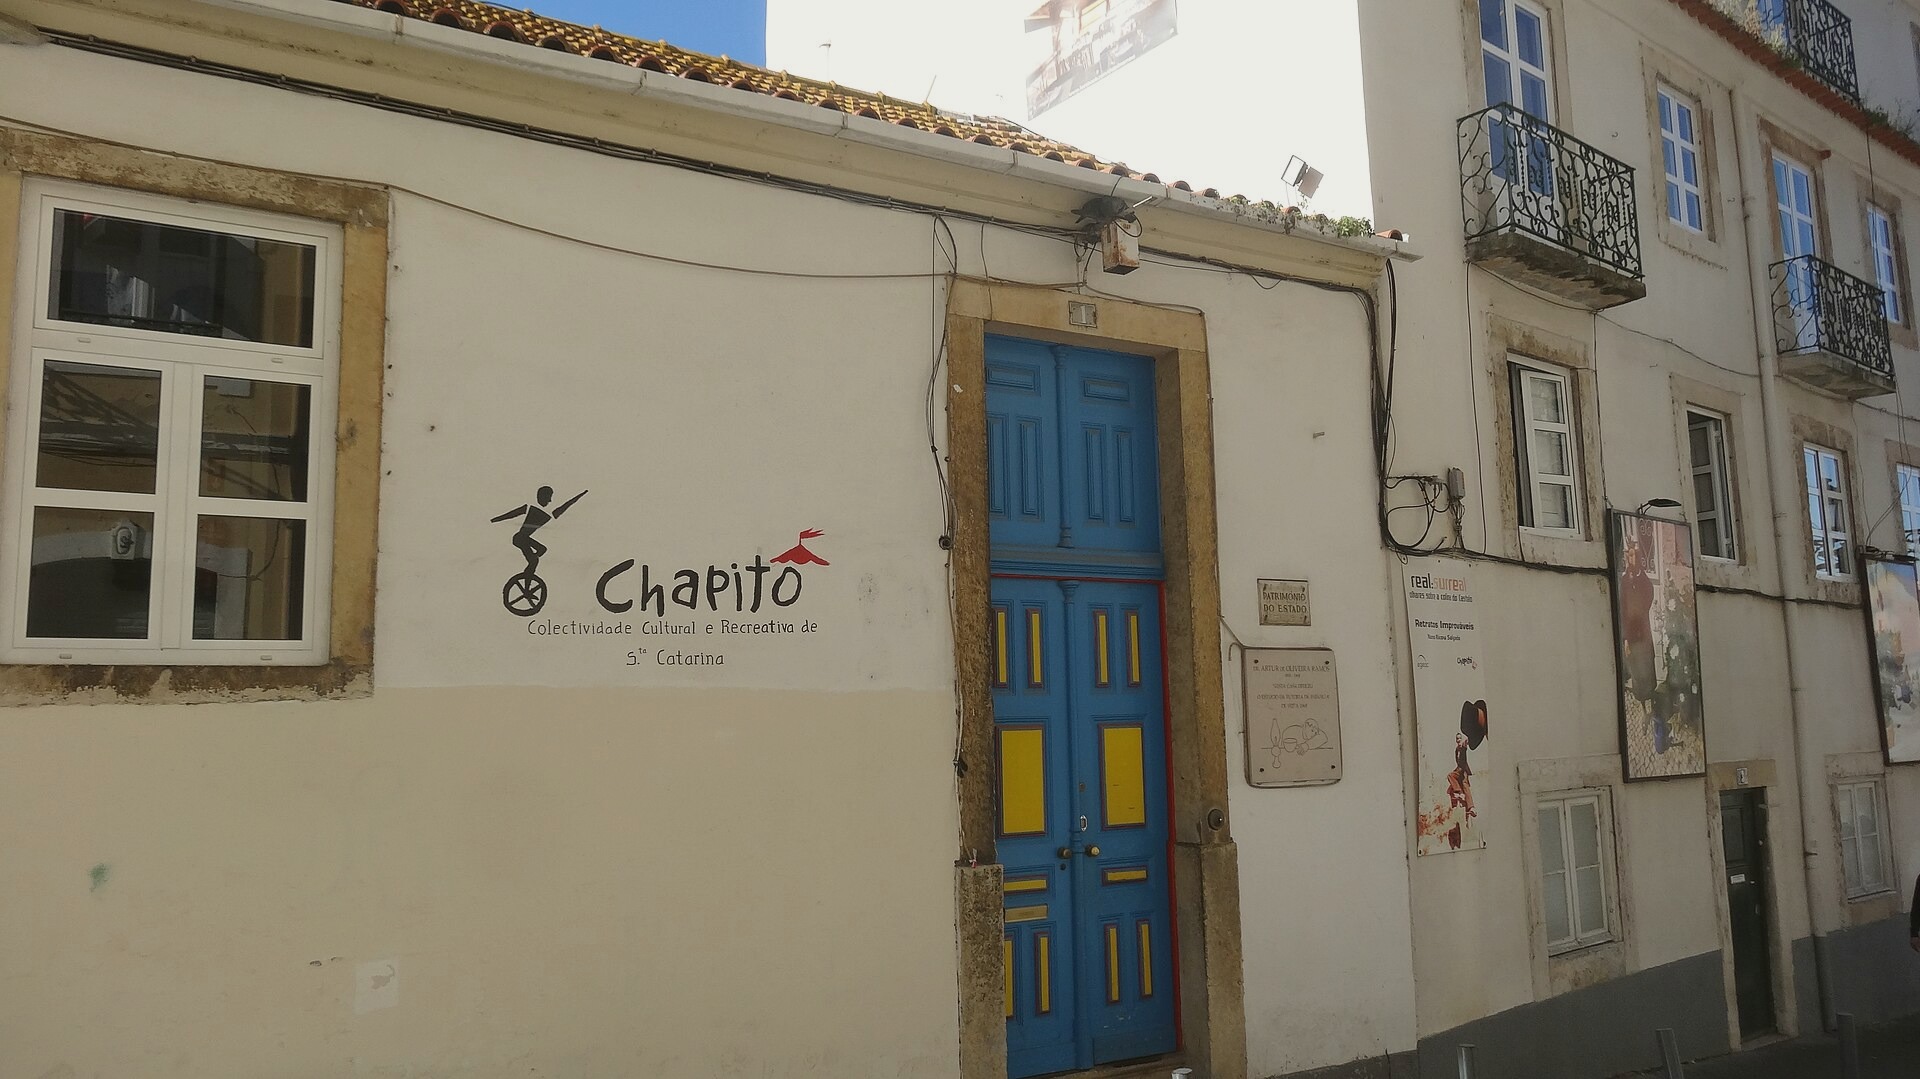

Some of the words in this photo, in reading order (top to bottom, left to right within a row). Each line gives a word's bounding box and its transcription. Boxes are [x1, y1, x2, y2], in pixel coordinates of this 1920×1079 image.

[1263, 604, 1275, 613] DO
[1278, 604, 1308, 614] ESTADO
[527, 619, 632, 636] Colectividade
[642, 620, 696, 635] Cultural
[705, 624, 714, 635] e
[720, 619, 794, 635] Recreativa
[801, 619, 818, 634] de
[1415, 619, 1439, 629] Retratos
[656, 649, 725, 666] Catarina
